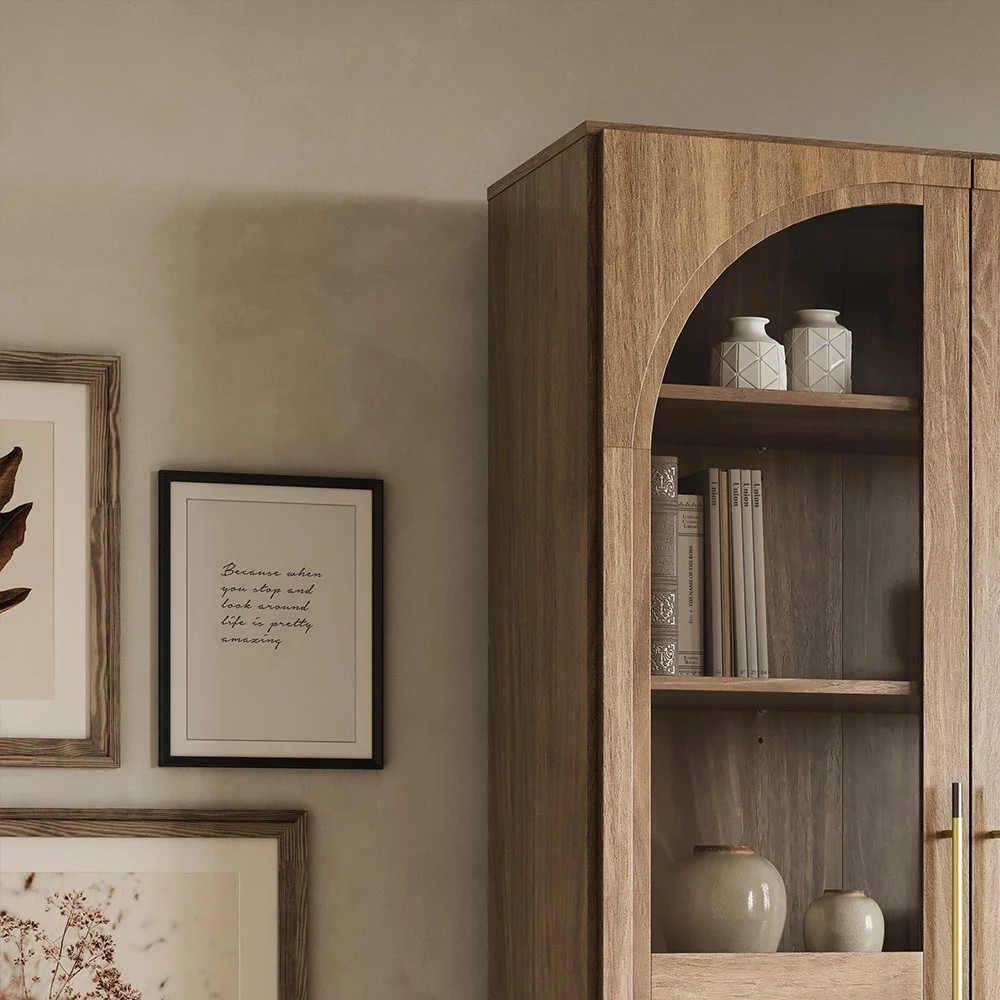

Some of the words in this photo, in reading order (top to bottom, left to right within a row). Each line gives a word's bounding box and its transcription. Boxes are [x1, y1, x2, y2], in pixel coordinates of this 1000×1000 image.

[220, 562, 281, 578] Because
[286, 567, 323, 578] when
[688, 571, 693, 579] OF
[221, 585, 247, 597] you
[253, 583, 282, 599] stop
[287, 584, 314, 595] and
[221, 599, 252, 610] look
[257, 600, 309, 612] around
[221, 616, 247, 629] life
[251, 616, 264, 627] is
[267, 617, 314, 634] pretty
[221, 634, 282, 650] amazing
